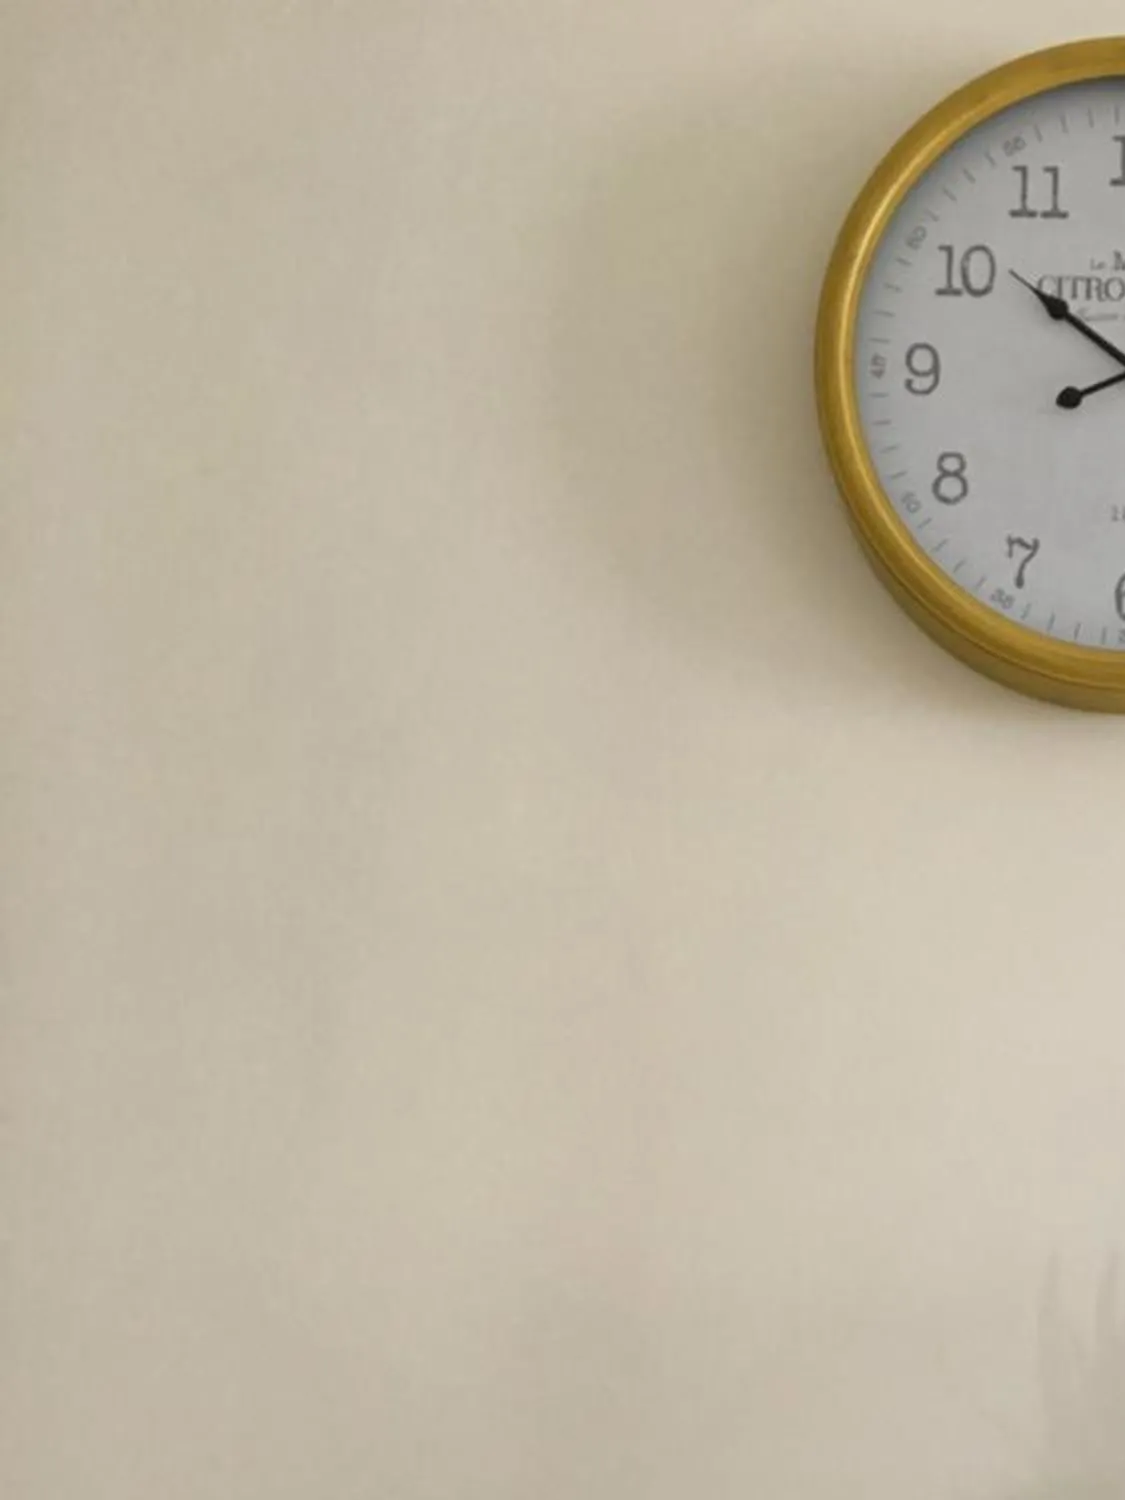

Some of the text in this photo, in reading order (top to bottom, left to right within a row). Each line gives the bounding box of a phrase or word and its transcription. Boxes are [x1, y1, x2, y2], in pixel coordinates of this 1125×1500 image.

[1008, 165, 1069, 218] 11
[935, 244, 997, 298] 10
[904, 342, 941, 396] 9
[932, 451, 968, 505] 8
[1006, 533, 1040, 589] 7
